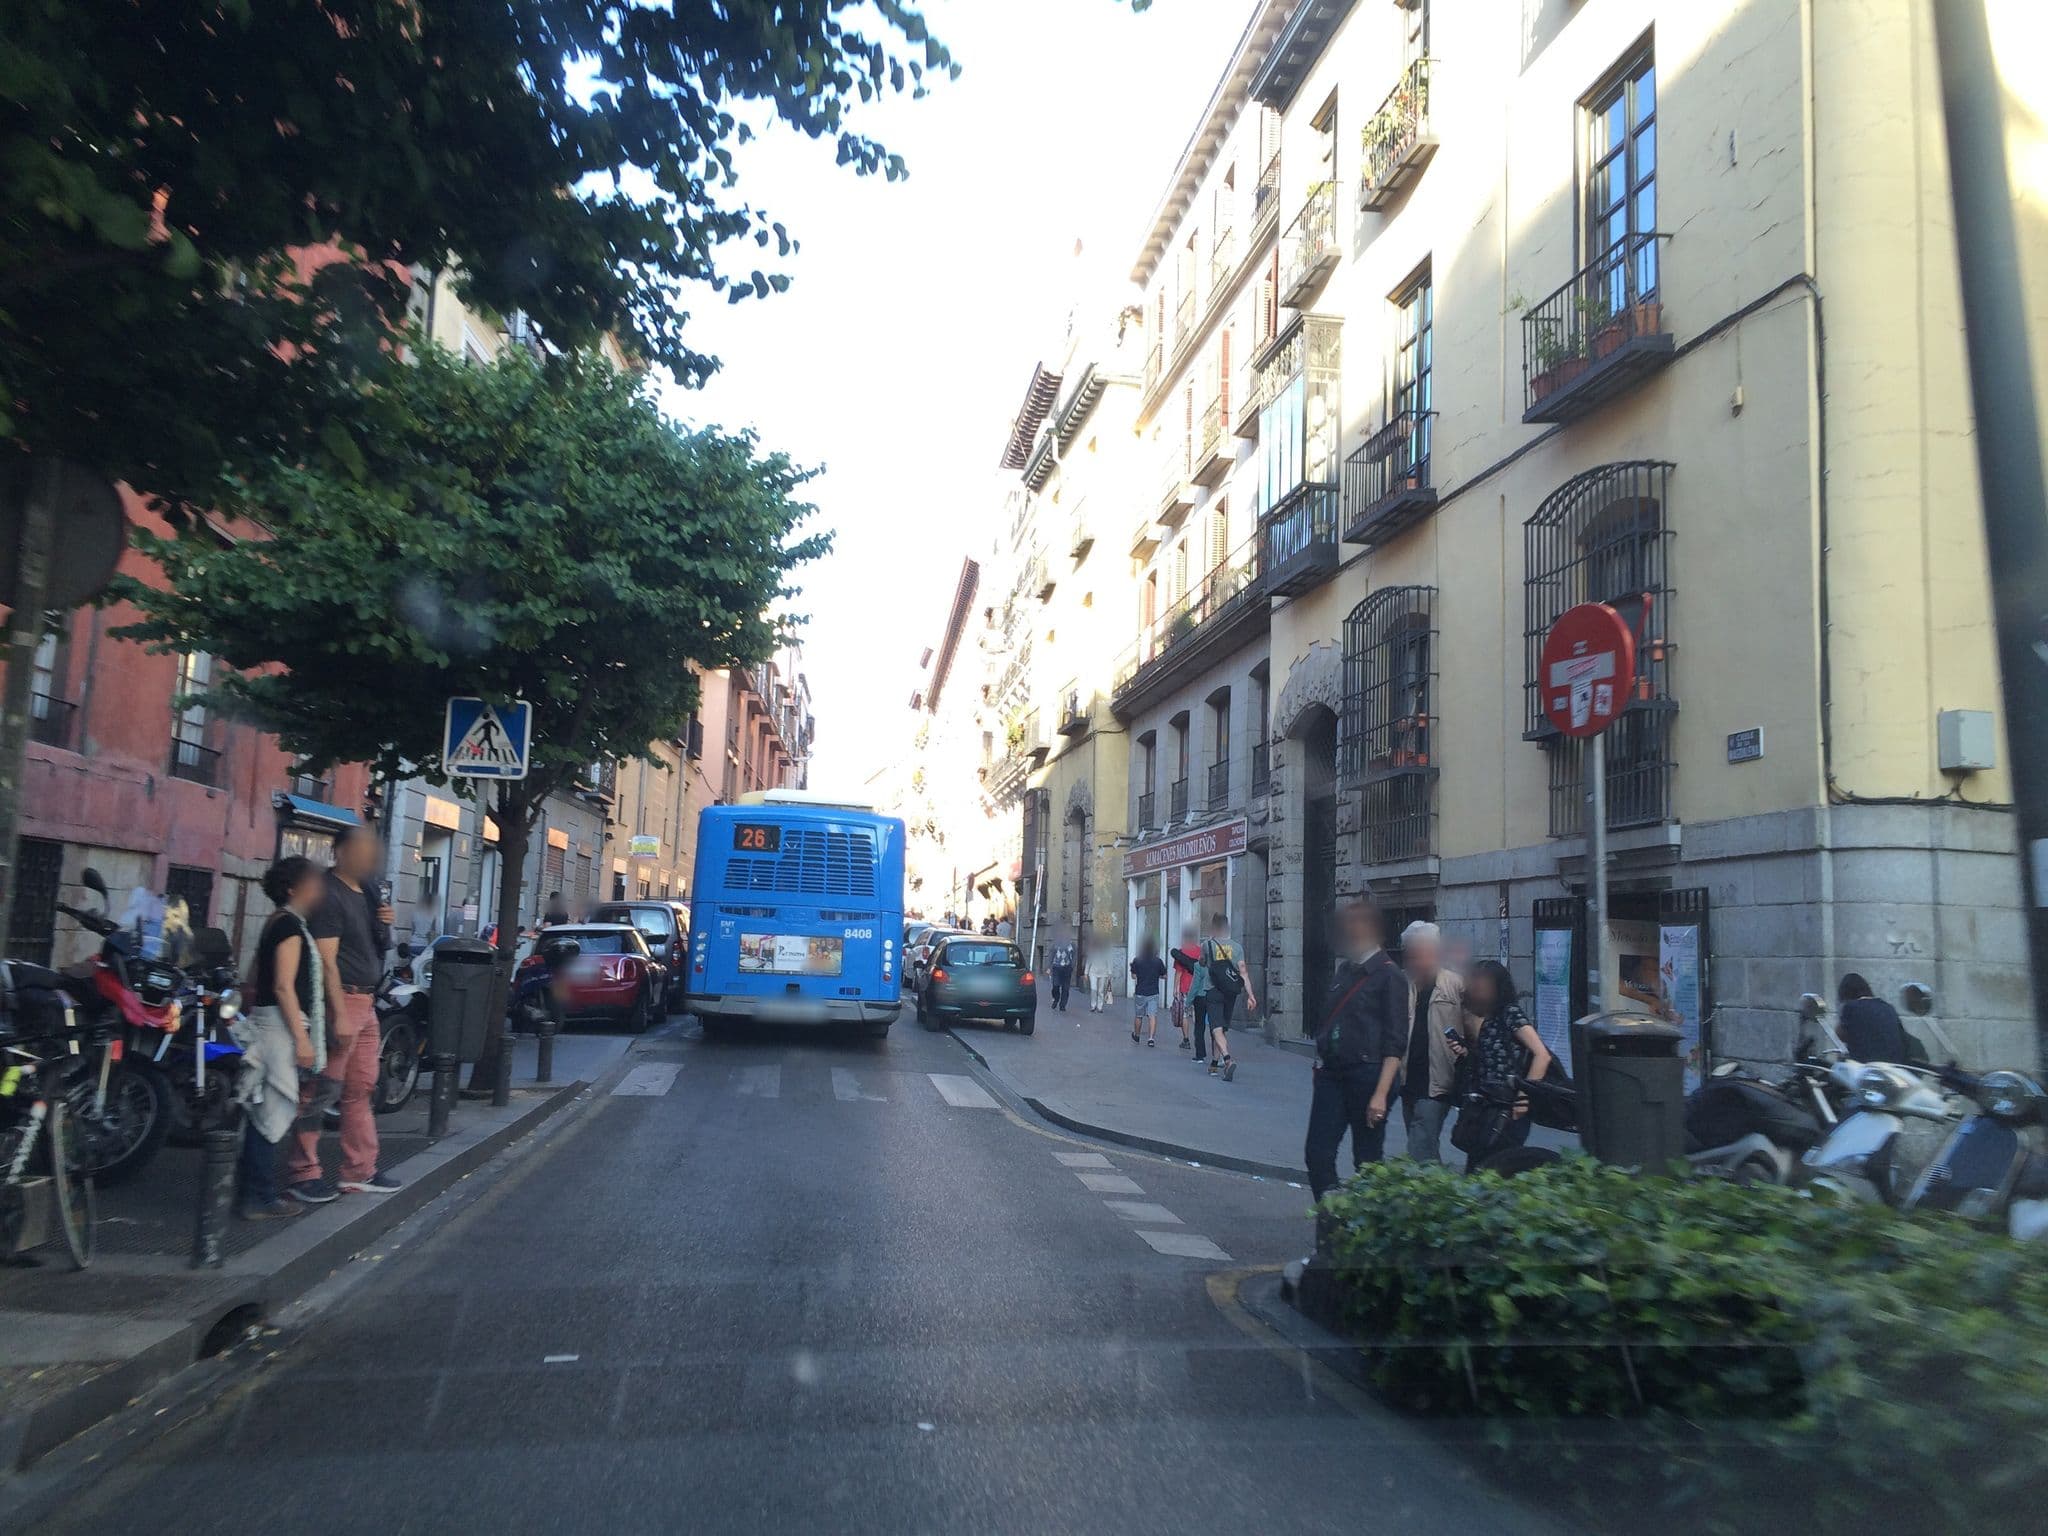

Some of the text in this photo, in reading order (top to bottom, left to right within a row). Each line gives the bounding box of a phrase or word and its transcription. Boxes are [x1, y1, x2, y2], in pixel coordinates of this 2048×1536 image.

[741, 828, 766, 848] 26
[1145, 846, 1176, 866] ALMACENES
[1176, 833, 1216, 860] MADRILEÑOS
[844, 928, 873, 940] 8408
